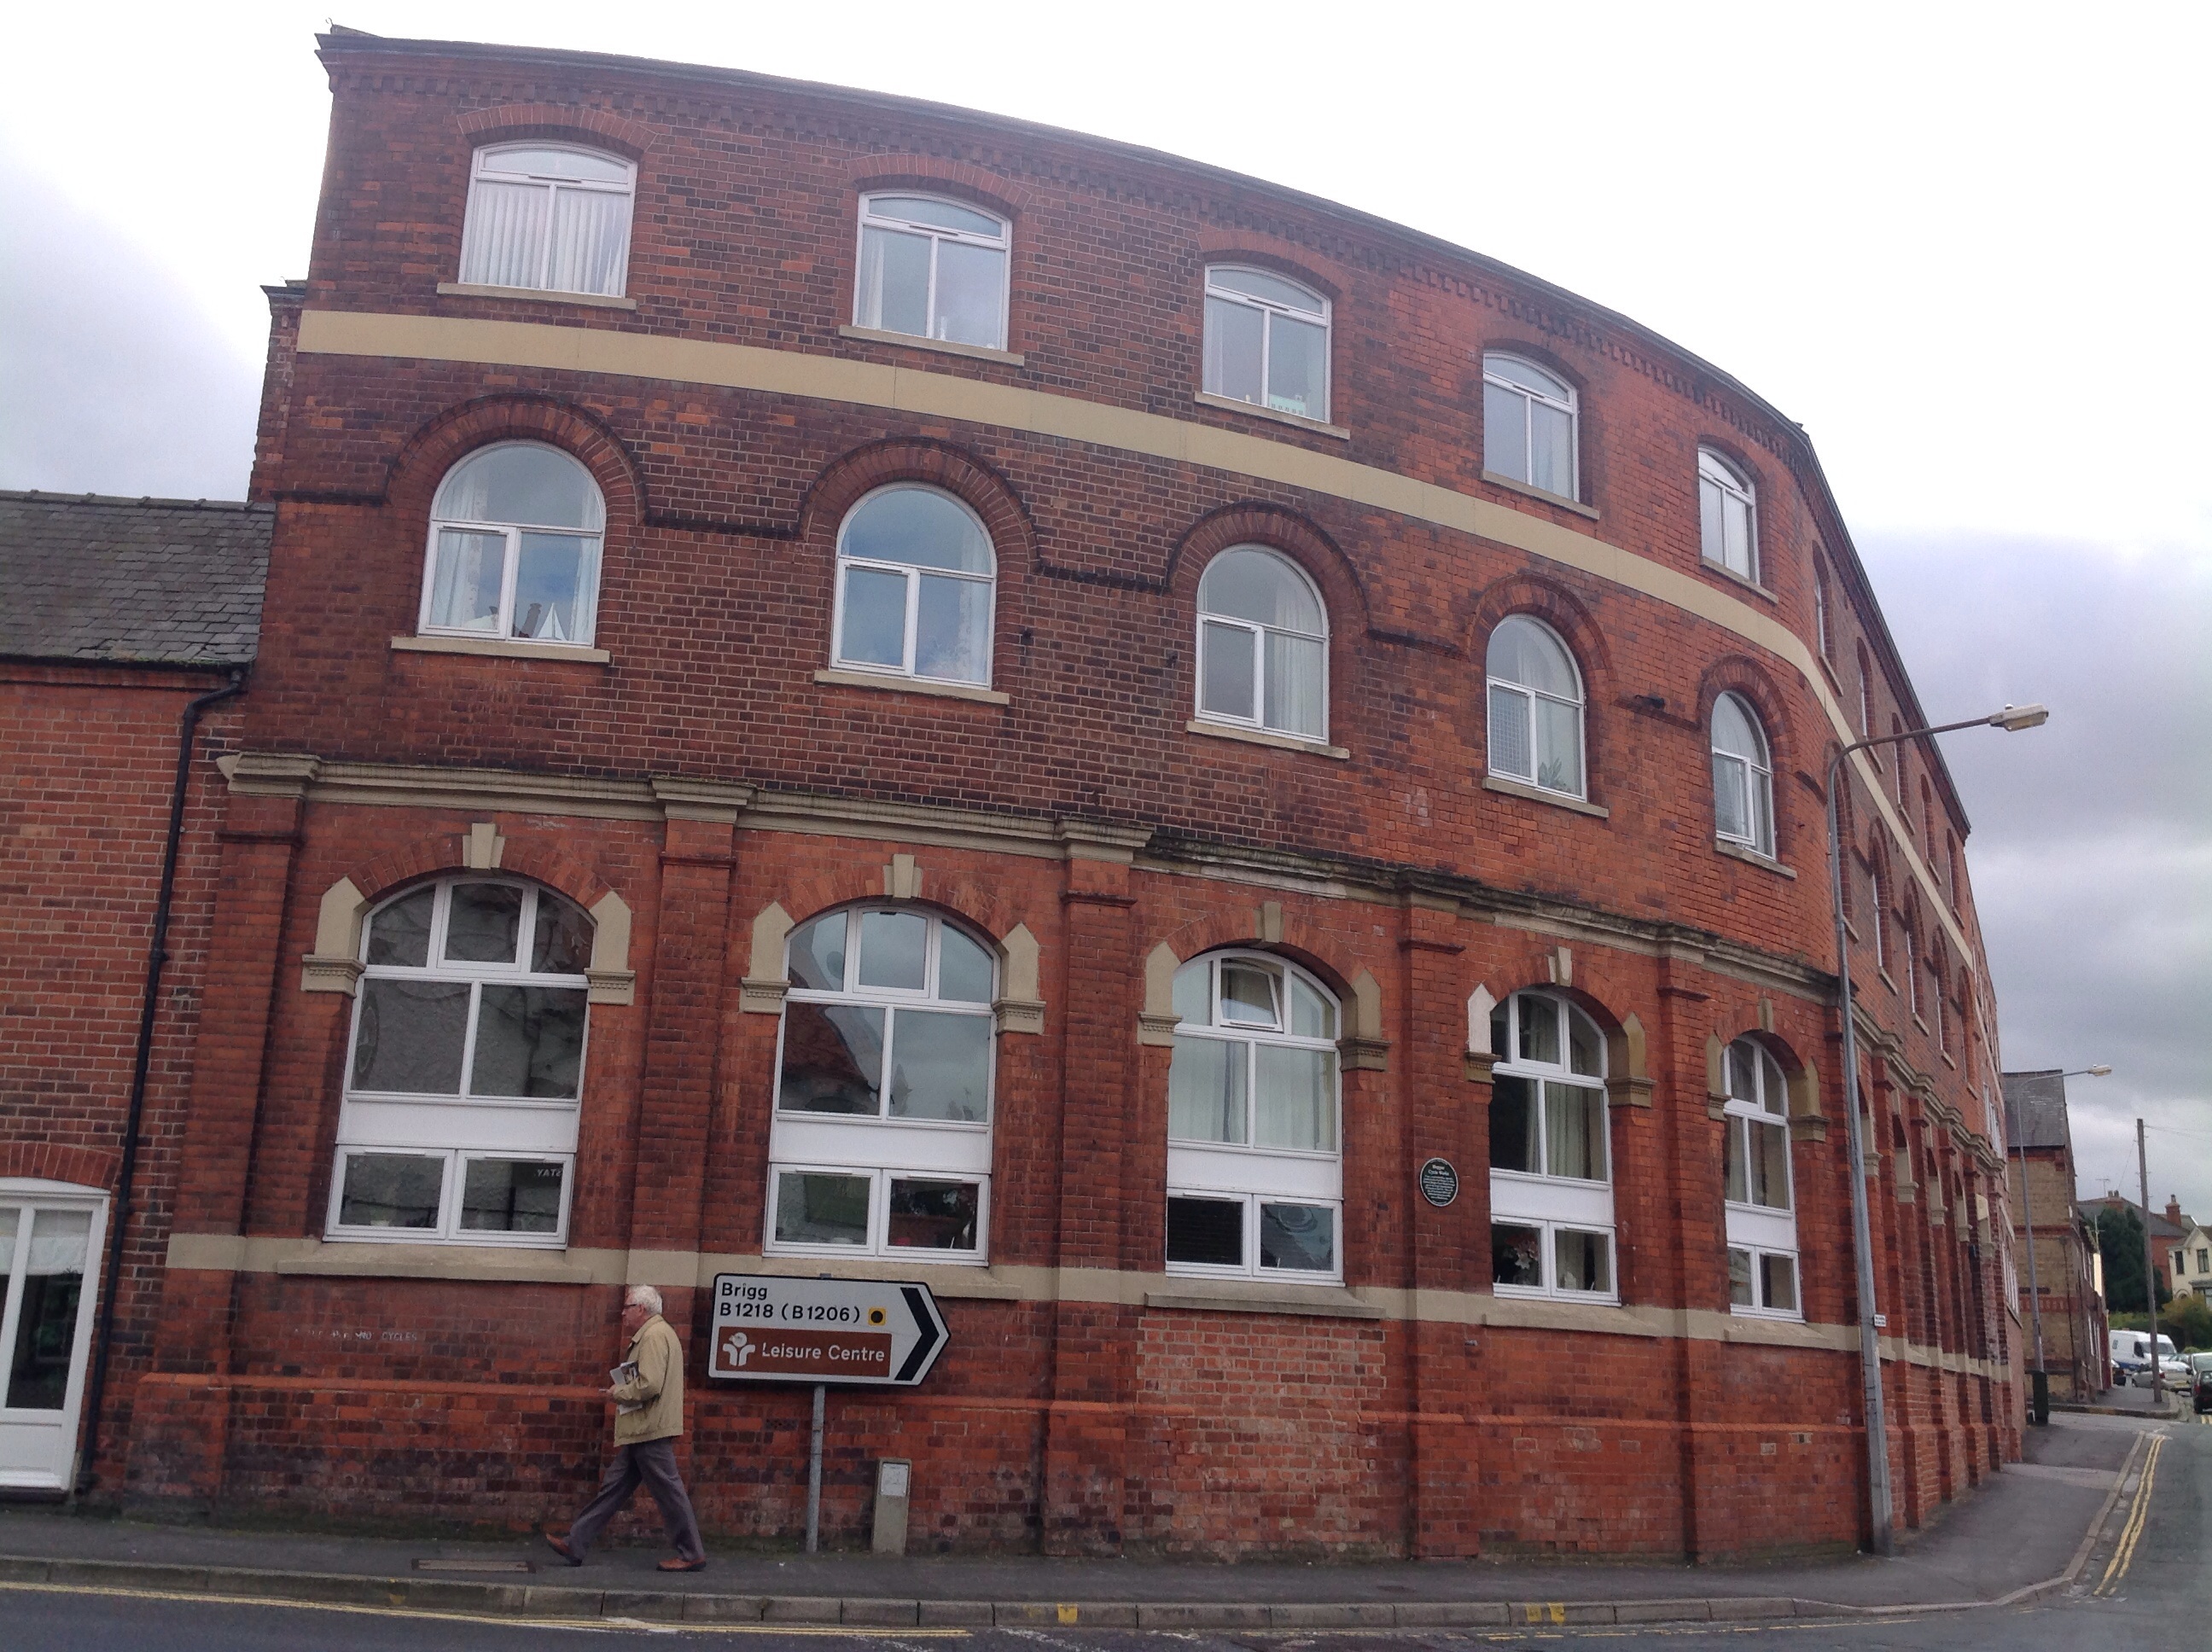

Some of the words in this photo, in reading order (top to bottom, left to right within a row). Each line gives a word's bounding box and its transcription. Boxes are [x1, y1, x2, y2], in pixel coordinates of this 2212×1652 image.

[721, 1282, 768, 1300] Brigg
[719, 1302, 774, 1319] B1218
[781, 1302, 861, 1323] (B1206)
[381, 1331, 418, 1341] CYCLES
[762, 1341, 822, 1360] Leisure
[828, 1344, 886, 1363] Centre
